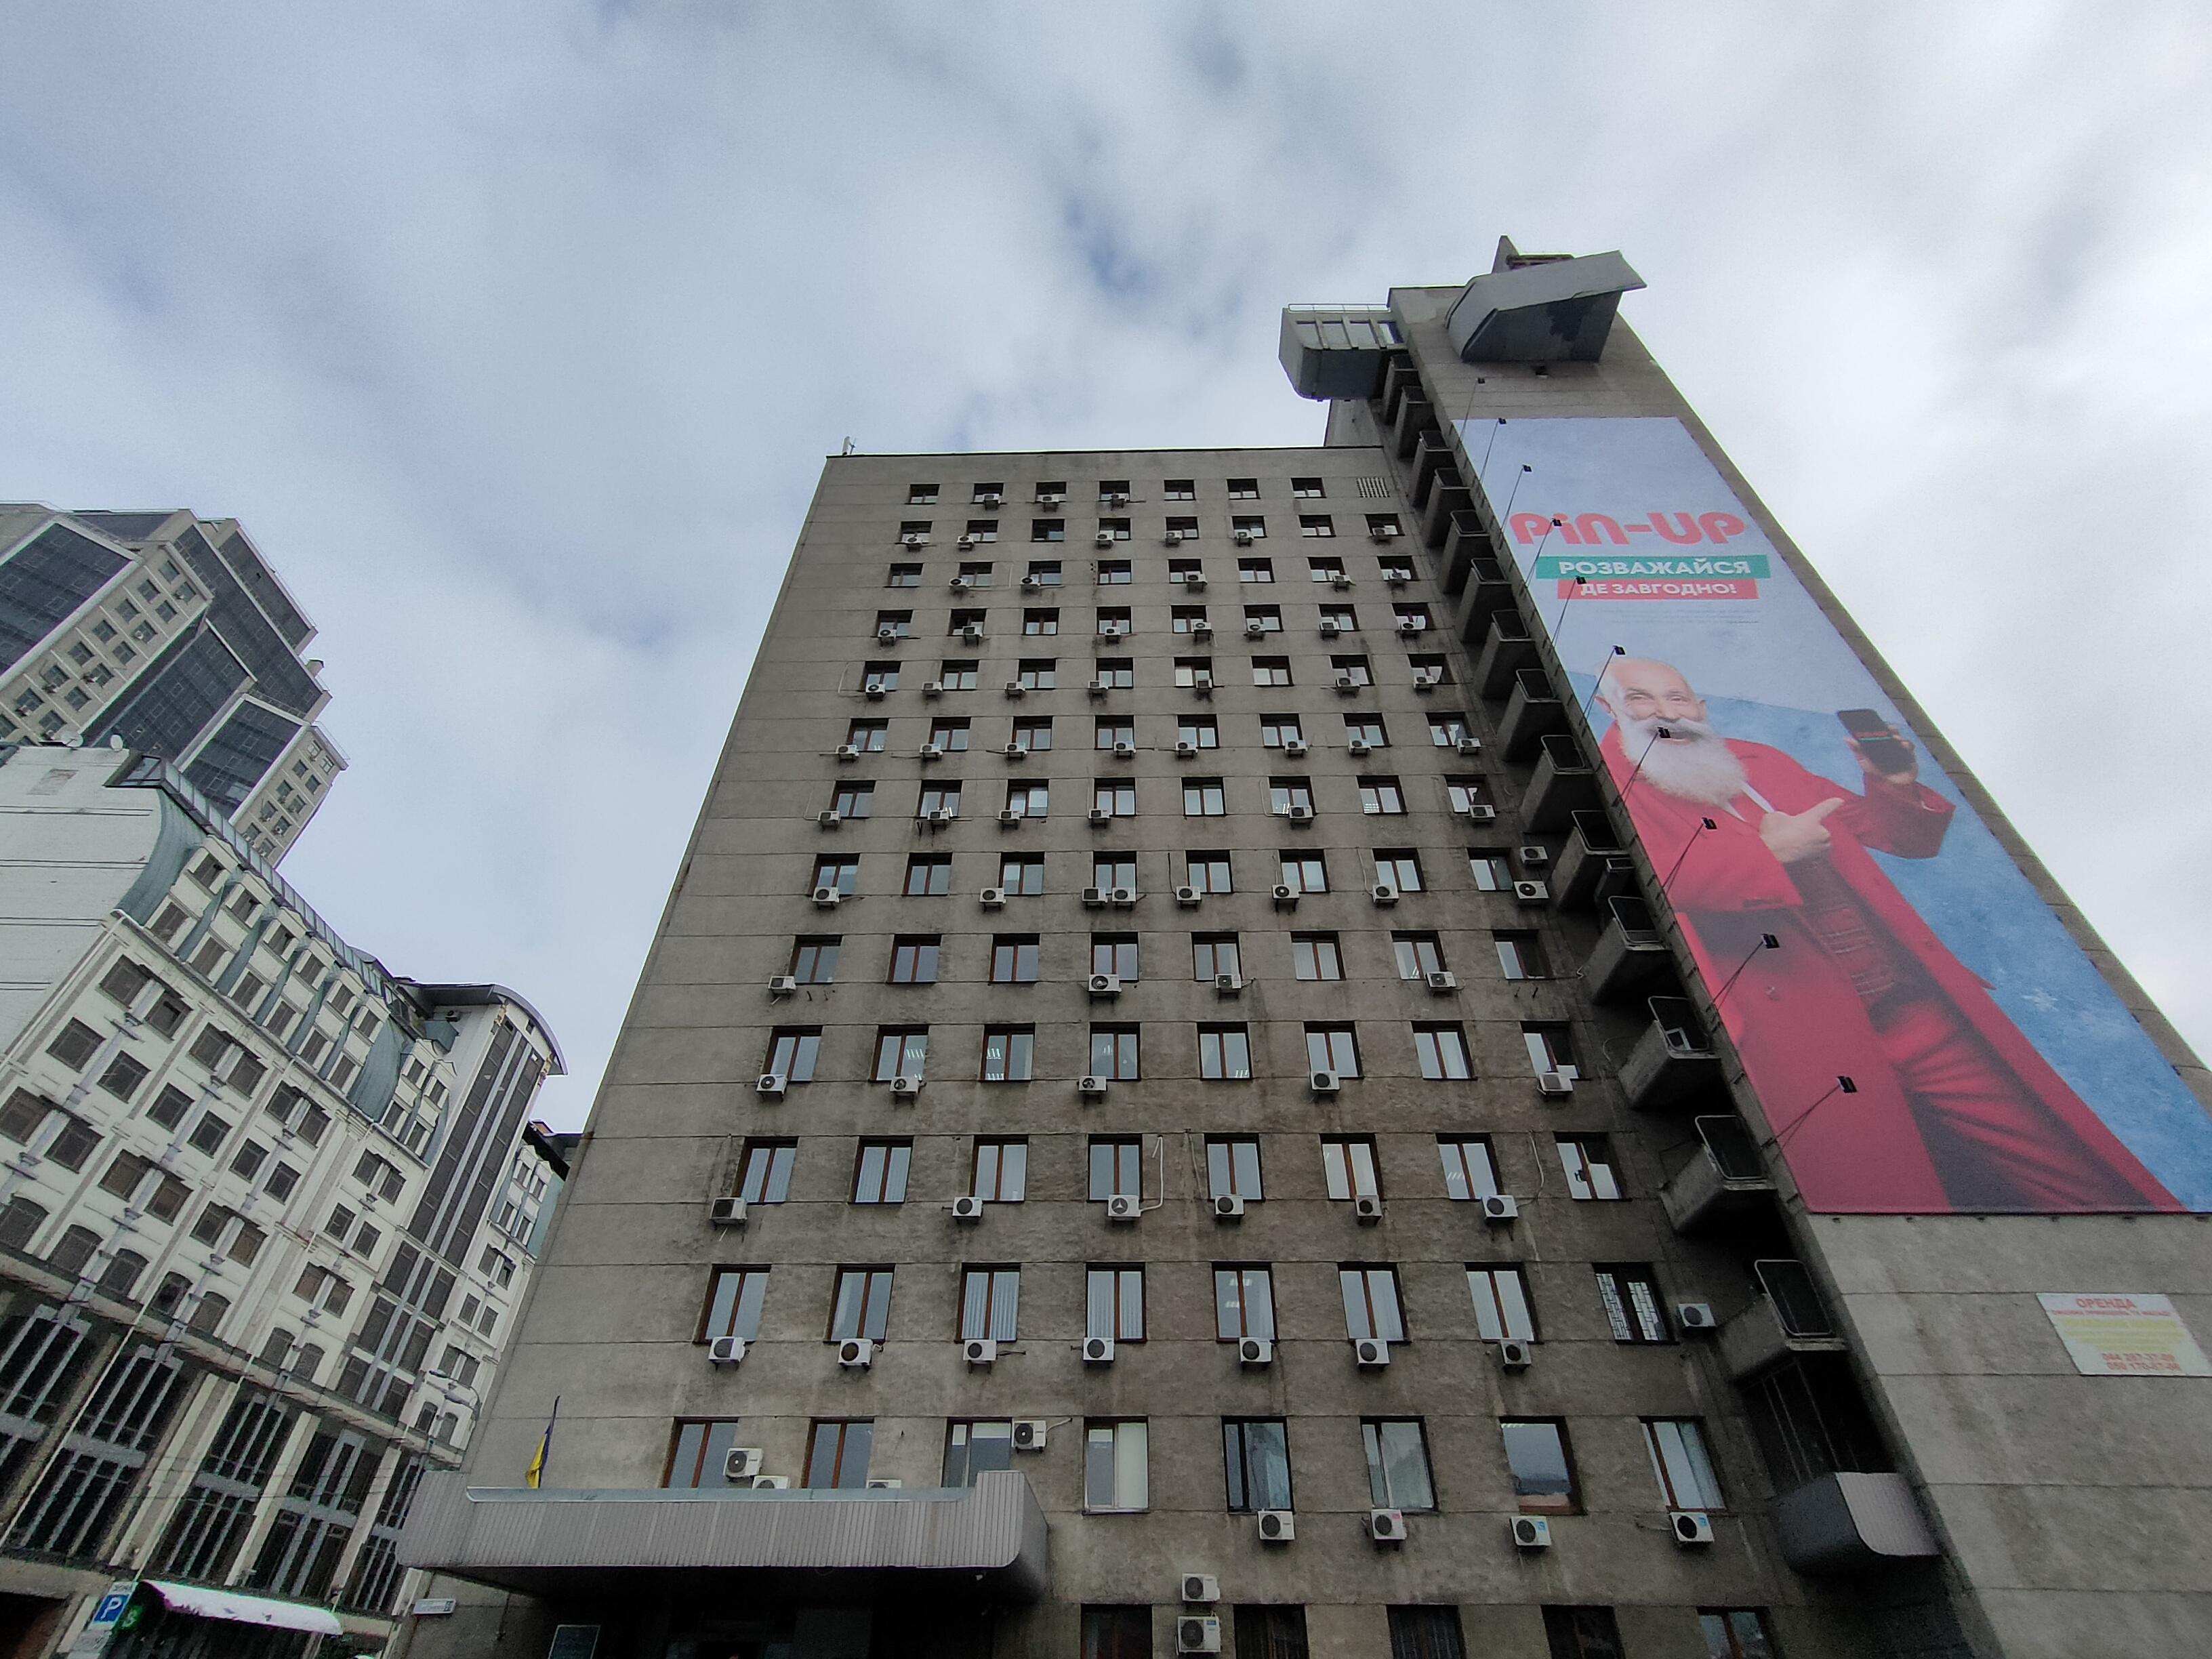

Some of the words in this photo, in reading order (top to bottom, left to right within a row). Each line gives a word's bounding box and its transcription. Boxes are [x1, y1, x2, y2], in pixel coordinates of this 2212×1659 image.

[1559, 558, 1751, 575] РОЗВАЖАЙСЯ
[1580, 583, 1608, 595] ДЕ
[1612, 583, 1737, 596] ЗАВГОДНО!
[2076, 1298, 2137, 1309] ОРЕНДА
